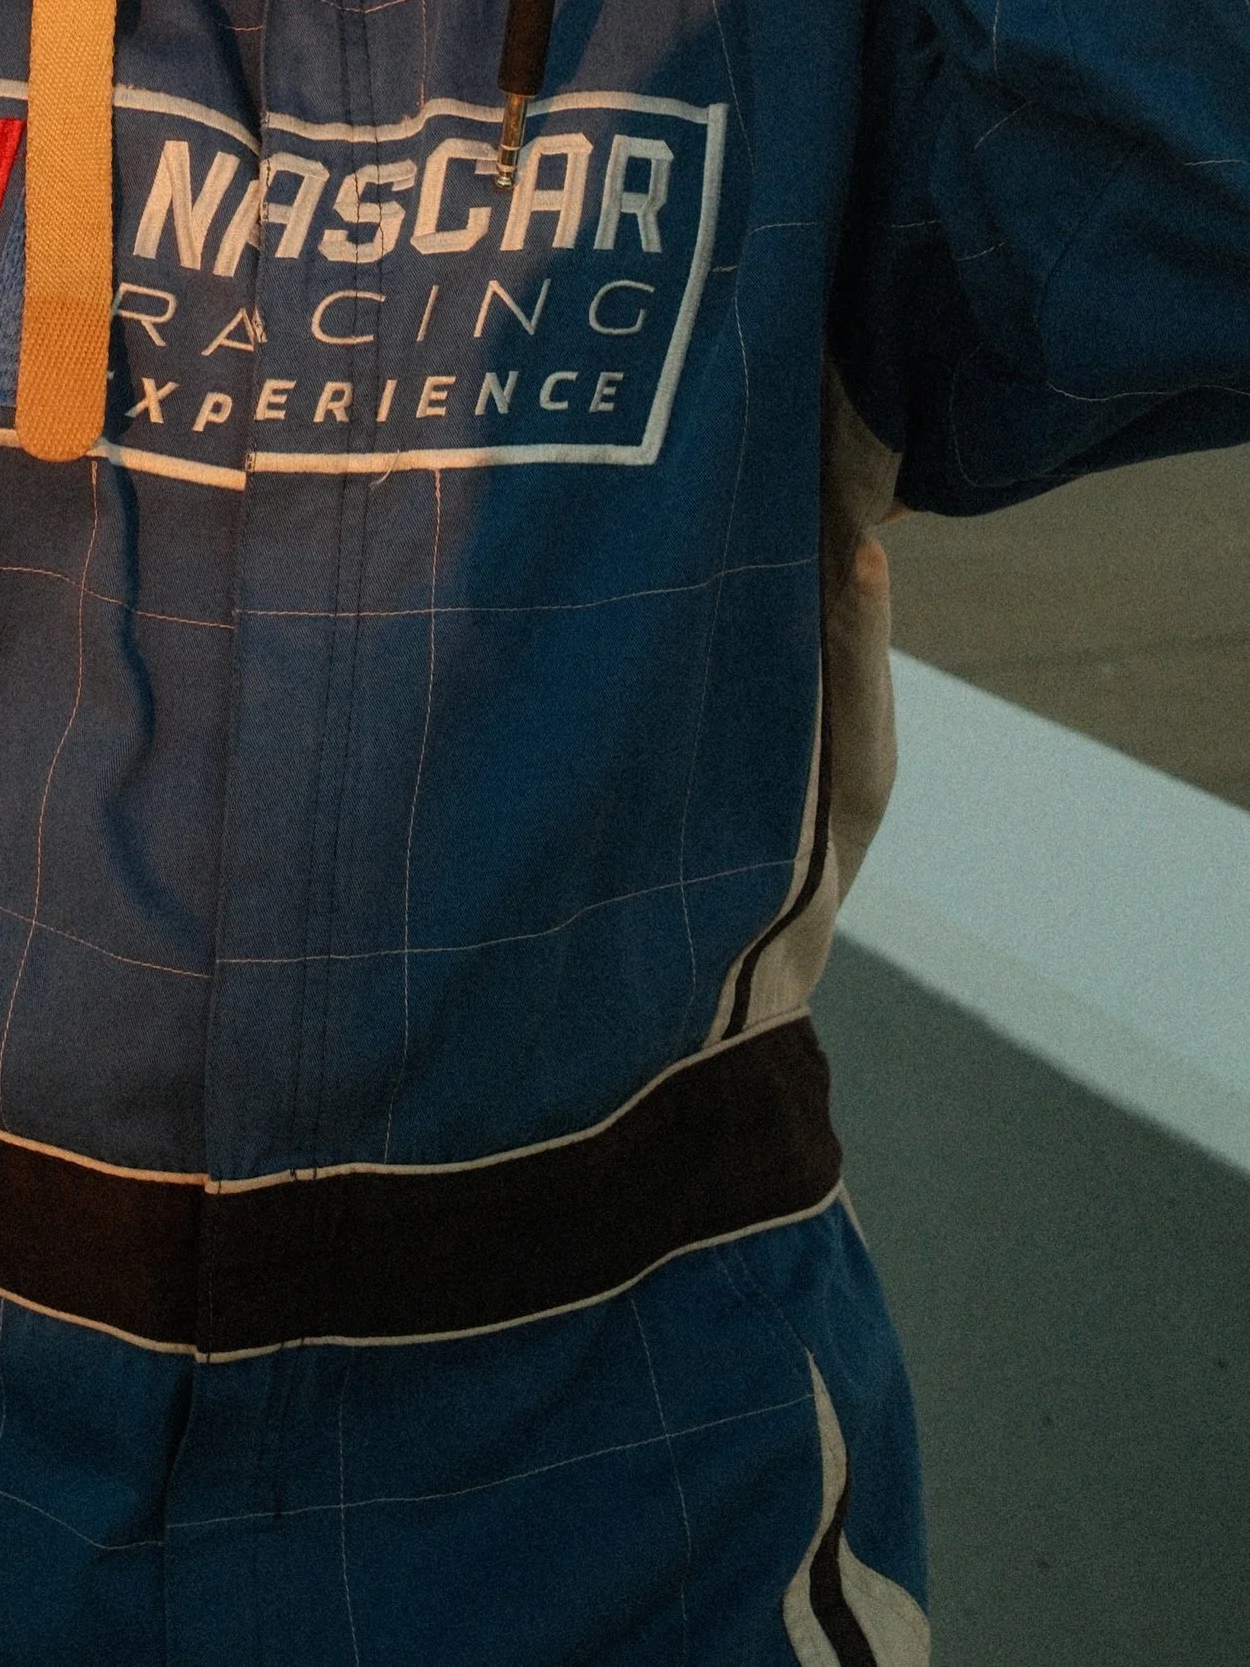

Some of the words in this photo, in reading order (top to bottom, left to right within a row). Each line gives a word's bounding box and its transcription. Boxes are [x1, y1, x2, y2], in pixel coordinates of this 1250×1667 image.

[133, 133, 676, 277] NASCAR
[112, 278, 657, 357] RACING
[107, 368, 626, 433] XPERIENCE
